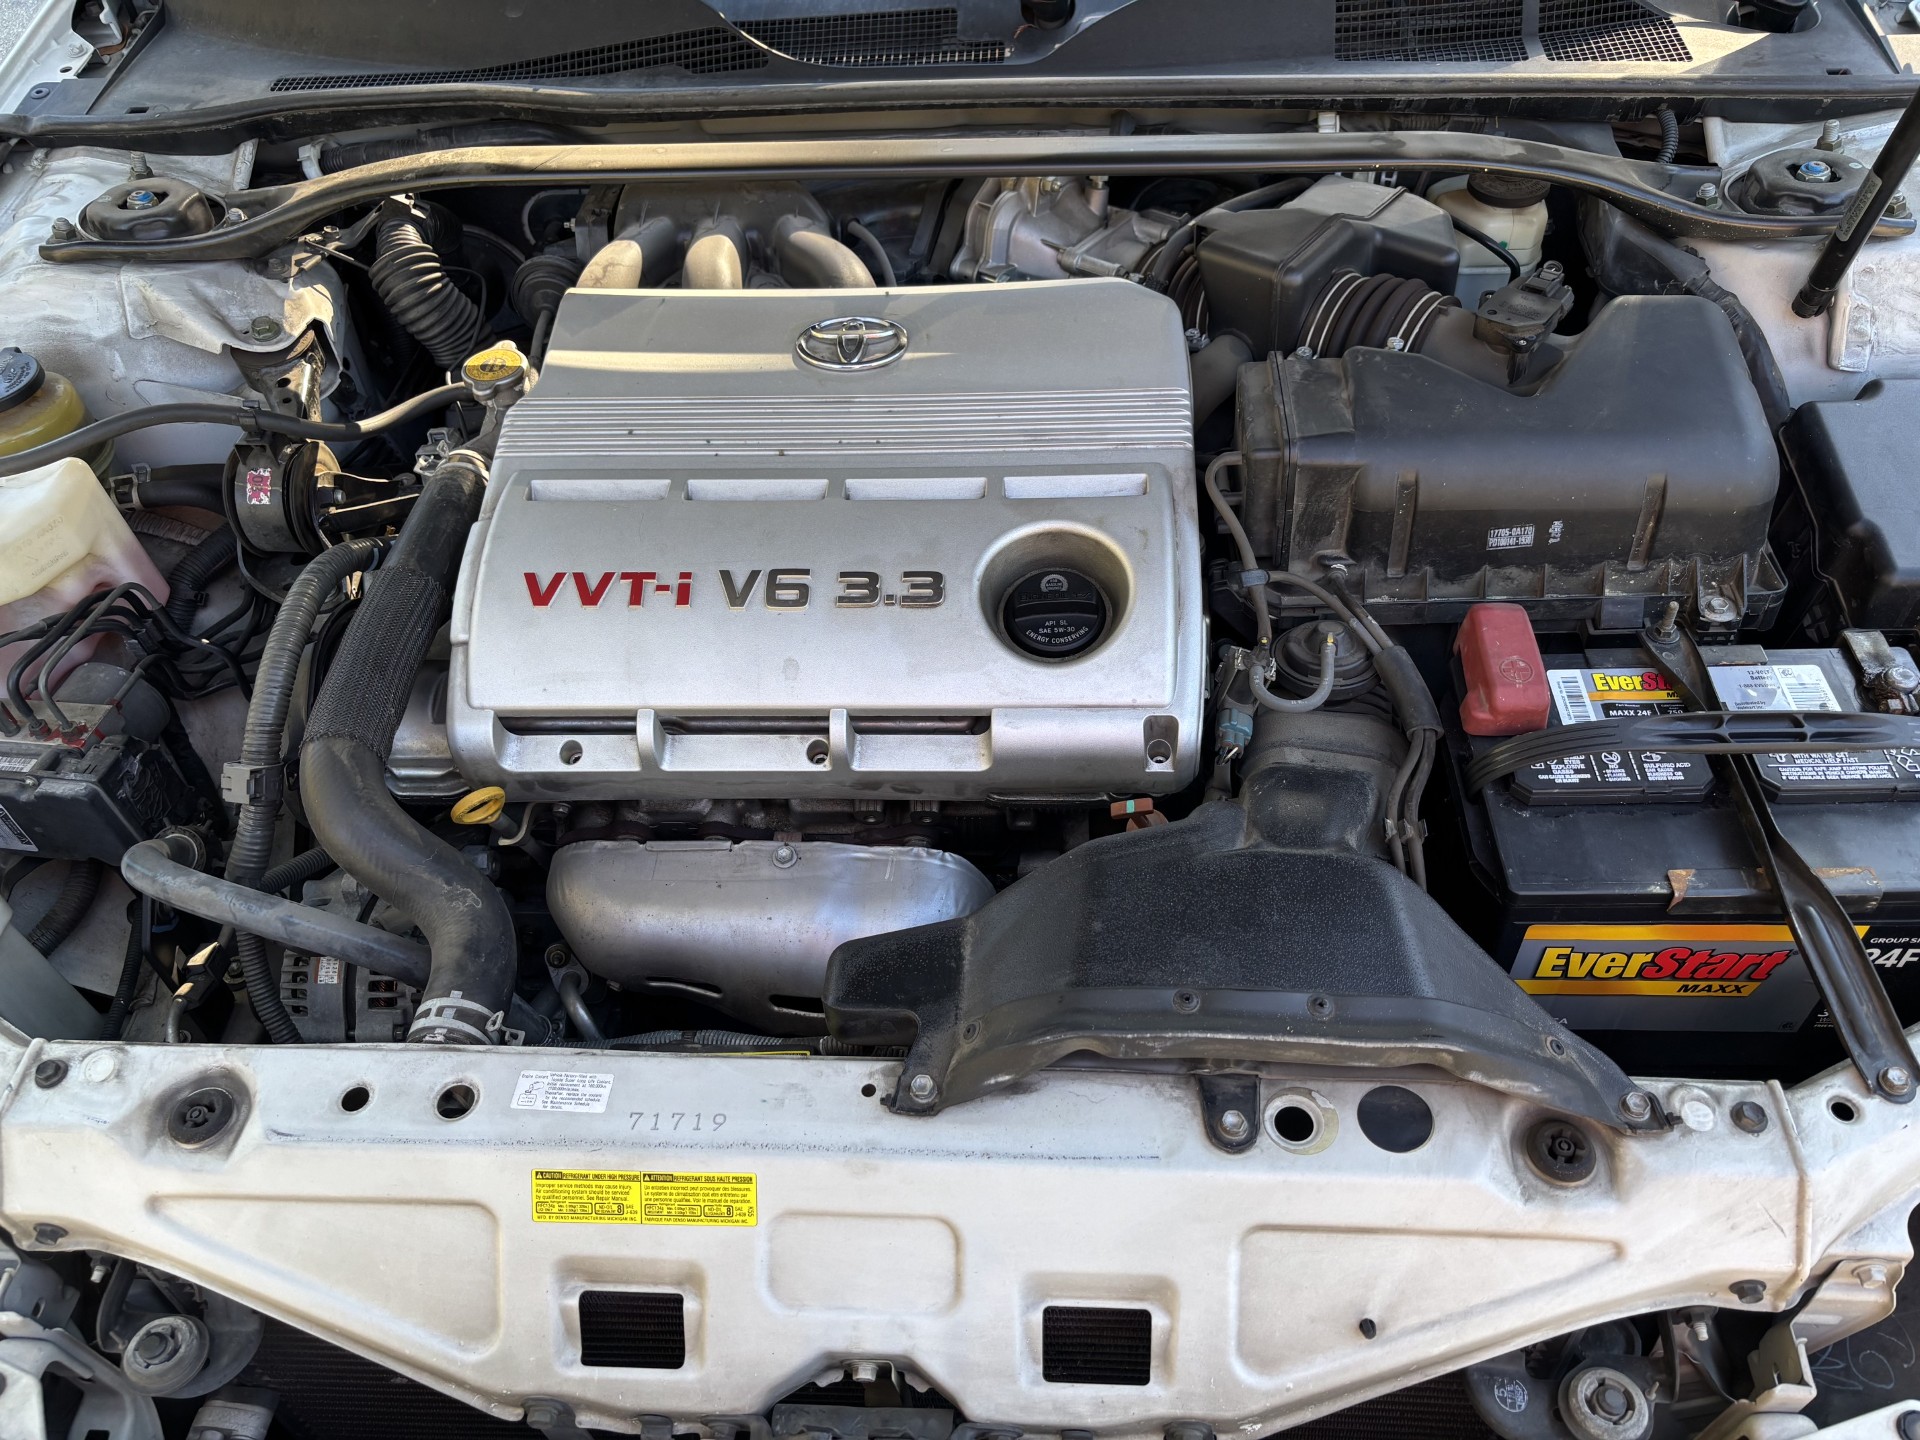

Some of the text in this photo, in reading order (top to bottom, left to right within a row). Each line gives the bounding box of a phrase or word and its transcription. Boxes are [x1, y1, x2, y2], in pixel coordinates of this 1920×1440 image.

[523, 568, 947, 611] VVT-i V6 3.3
[1026, 626, 1089, 644] ENERGY CONSERVING
[1591, 672, 1672, 691] EverSt
[1535, 947, 1793, 981] EverStart
[1676, 983, 1749, 994] MAXX
[629, 1112, 727, 1131] 71719
[617, 1204, 622, 1213] 8
[726, 1207, 731, 1215] 8
